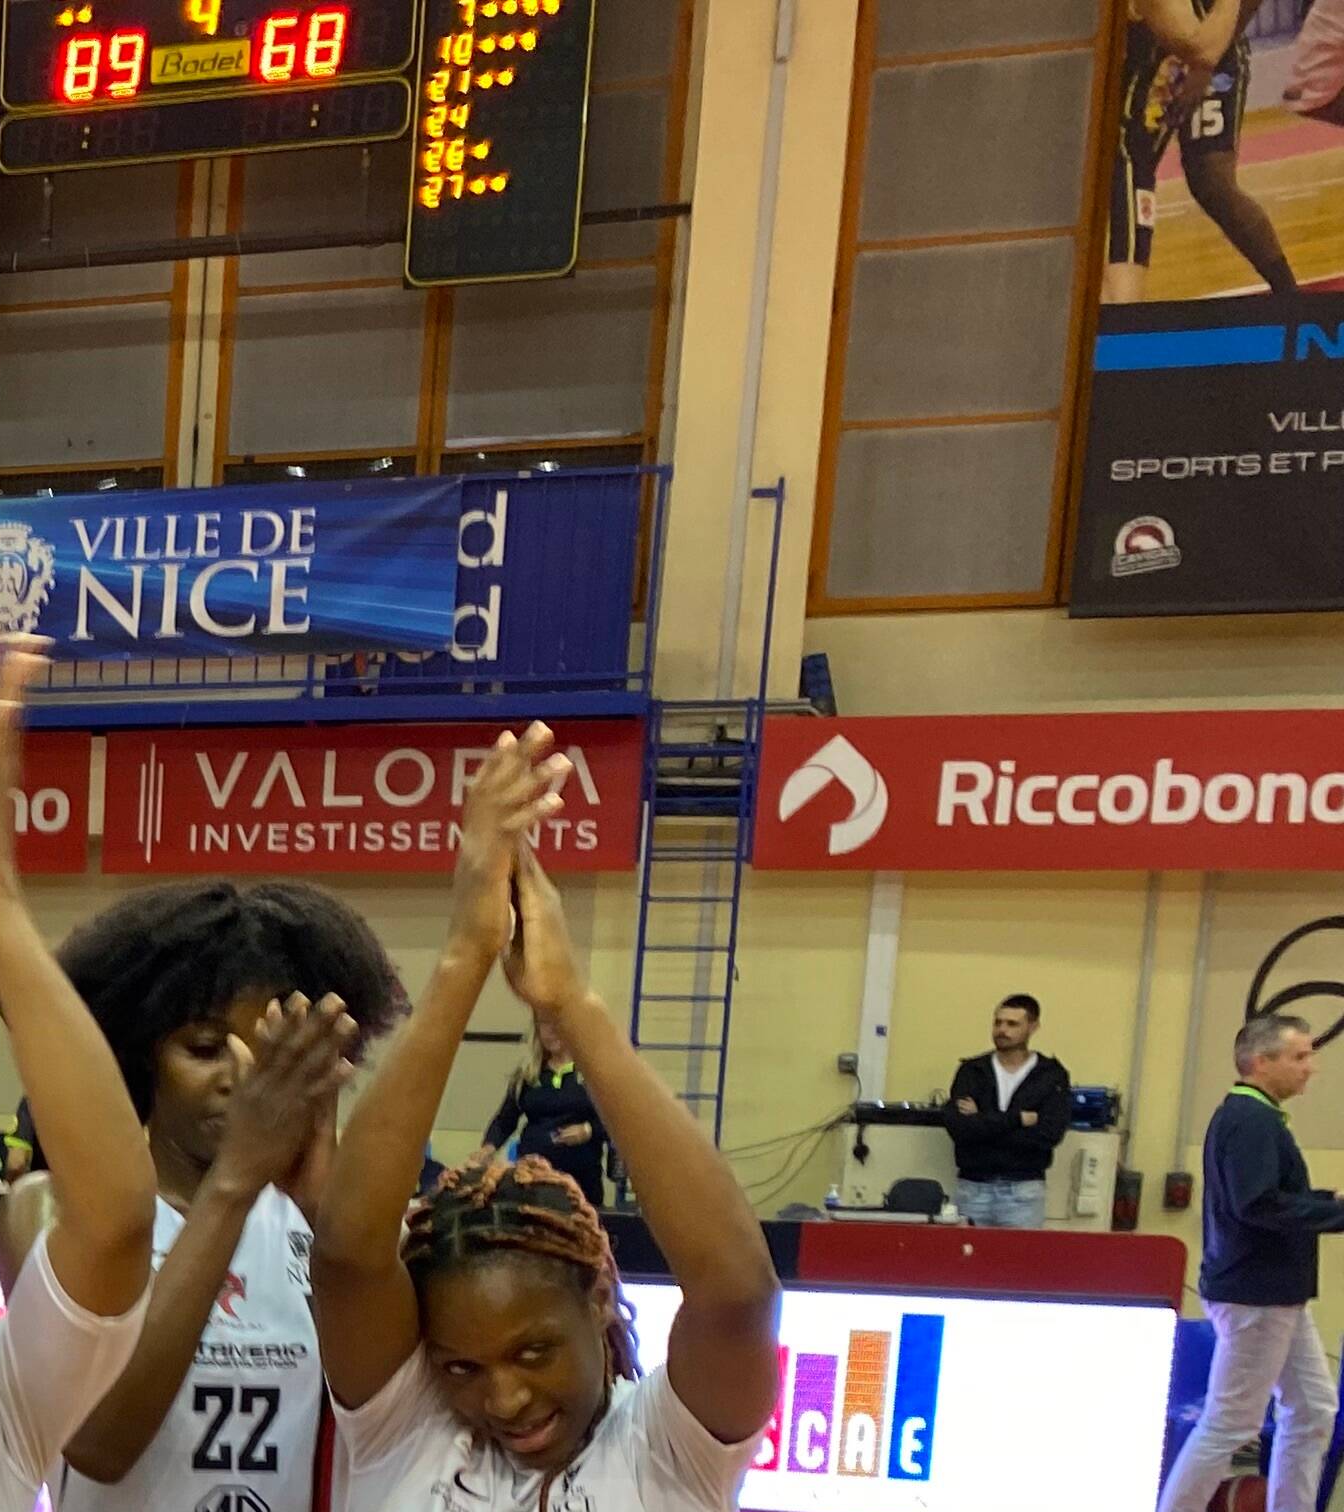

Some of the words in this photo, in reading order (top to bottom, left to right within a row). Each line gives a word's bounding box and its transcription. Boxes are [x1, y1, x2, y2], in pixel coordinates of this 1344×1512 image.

[61, 32, 146, 102] 89
[157, 49, 245, 78] Bodet
[256, 10, 348, 82] 68
[1111, 452, 1262, 481] SPORTS
[1269, 450, 1316, 474] ET
[70, 510, 221, 562] VILLE
[242, 506, 316, 557] DE
[69, 556, 312, 641] NICE
[191, 1385, 281, 1472] 22
